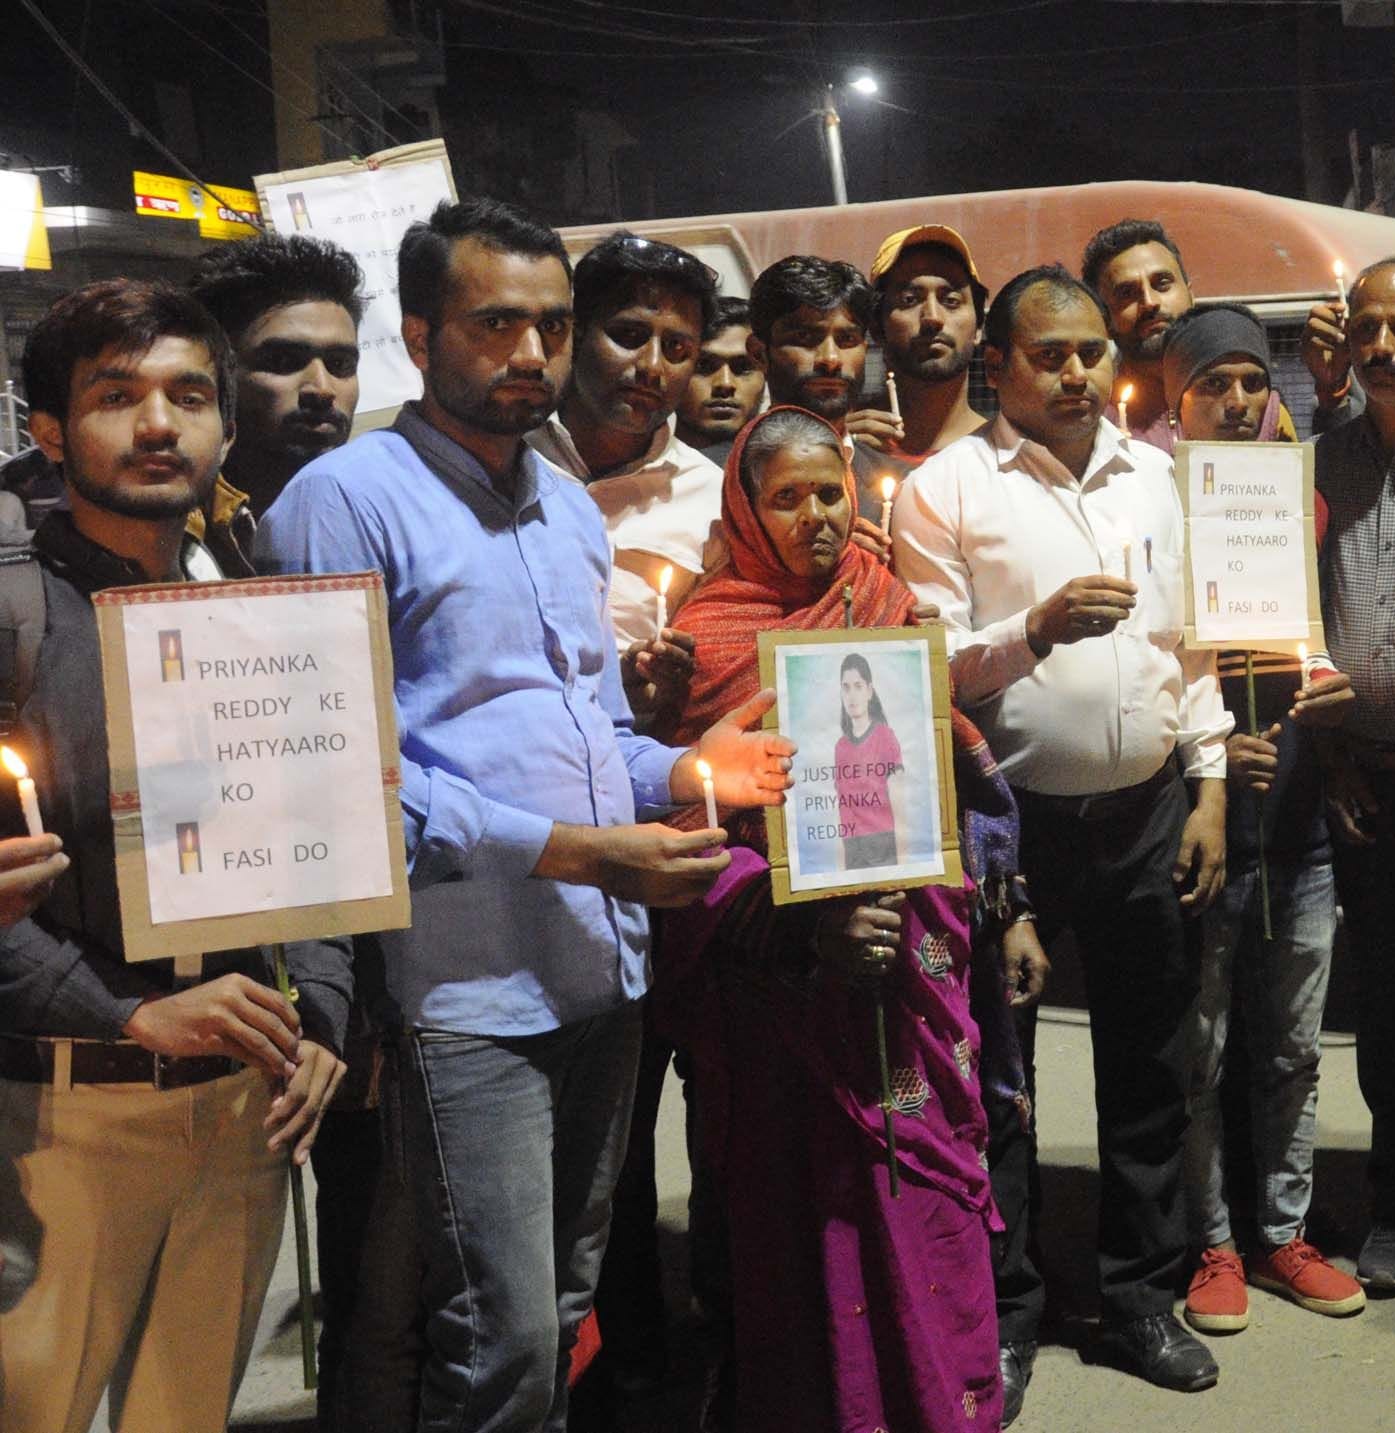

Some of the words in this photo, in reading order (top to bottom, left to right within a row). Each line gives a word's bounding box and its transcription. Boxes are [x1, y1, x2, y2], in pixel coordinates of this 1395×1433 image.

[1220, 484, 1277, 496] PRIYANKA
[1226, 510, 1263, 521] REDDY
[1275, 510, 1288, 521] KE
[1227, 535, 1288, 547] HATYAARO
[1228, 560, 1244, 572] KO
[1229, 601, 1252, 613] FASI
[1262, 601, 1279, 613] DO
[199, 653, 318, 680] PRIYANKA
[213, 696, 292, 721] REDDY
[319, 692, 346, 711] KE
[217, 733, 347, 762] HATYAARO
[803, 764, 861, 783] JUSTICE
[866, 762, 896, 777] FOR
[221, 783, 254, 804] KO
[805, 792, 882, 811] PRIYANKA
[807, 823, 857, 840] REDDY
[223, 848, 272, 870] FASI
[294, 842, 329, 863] DO
